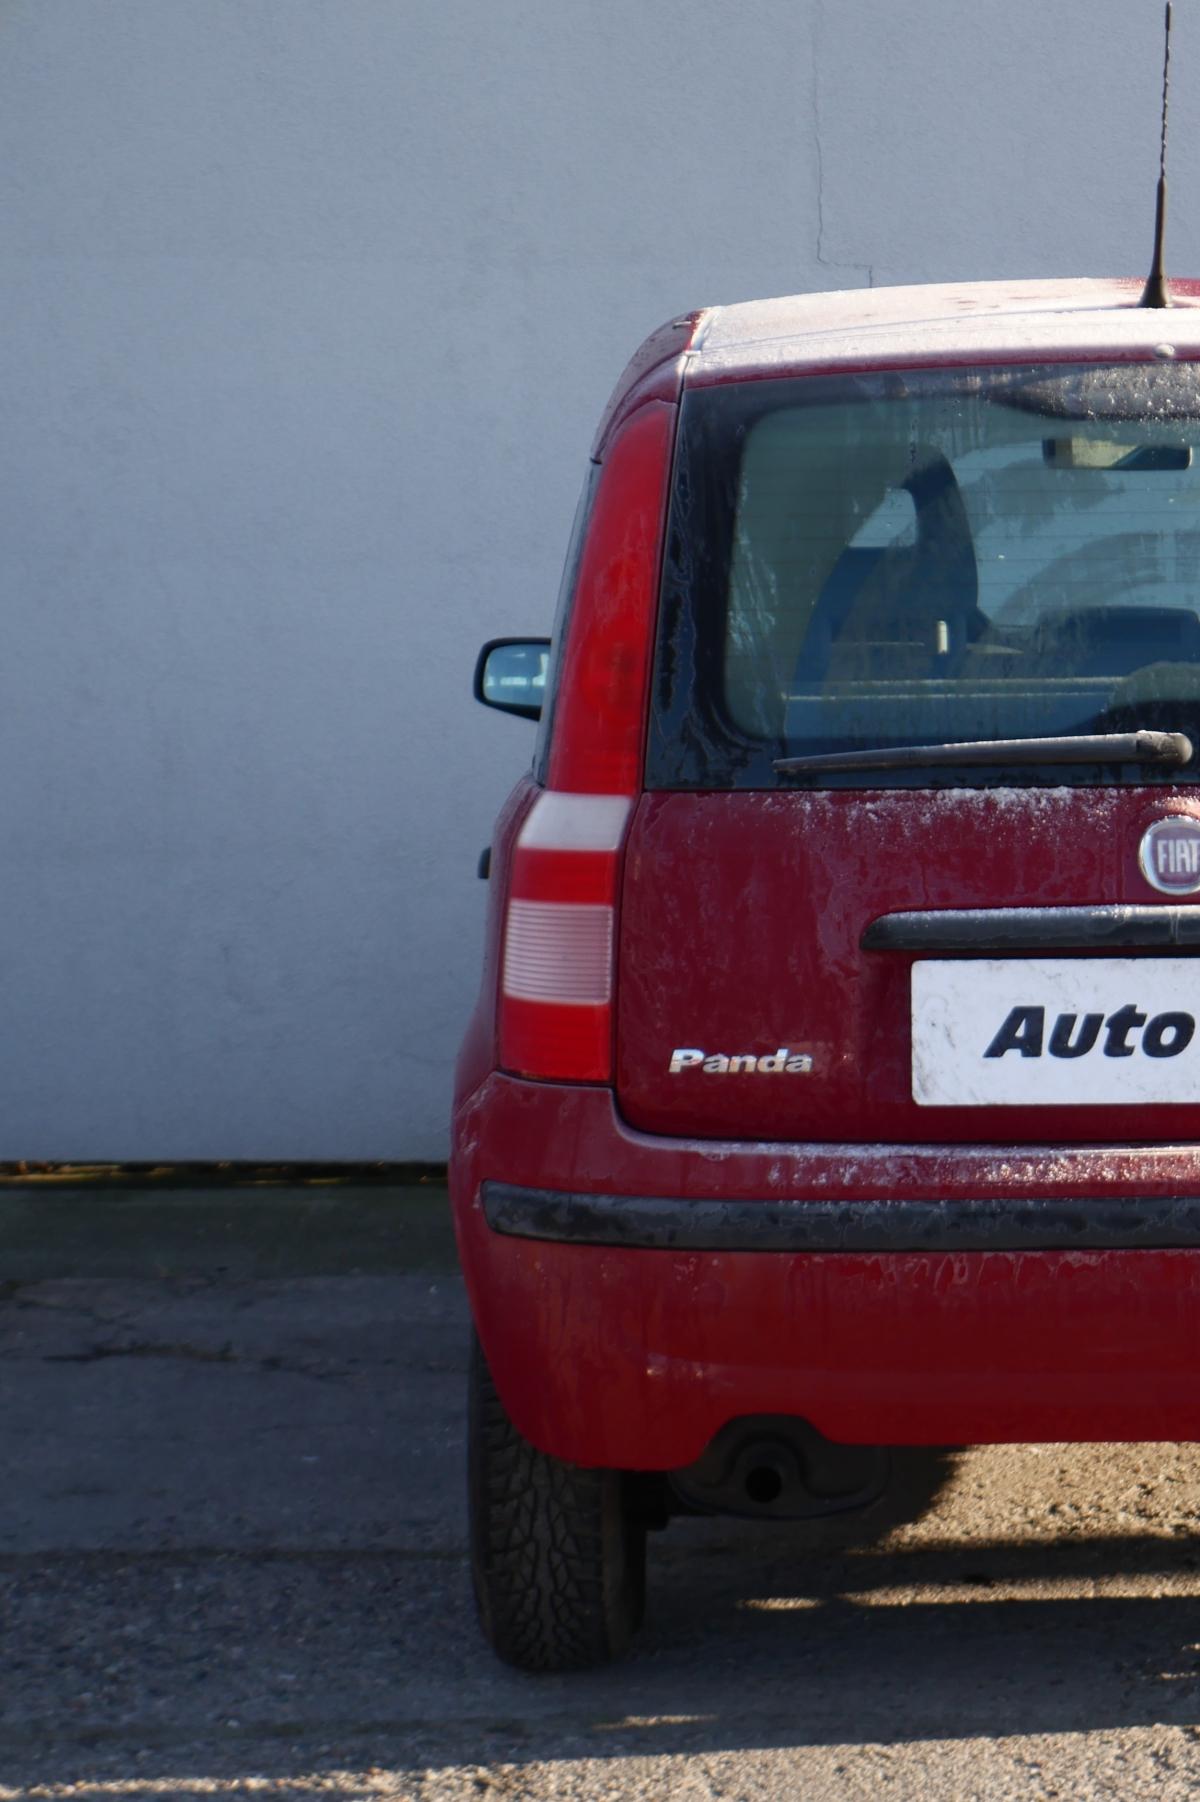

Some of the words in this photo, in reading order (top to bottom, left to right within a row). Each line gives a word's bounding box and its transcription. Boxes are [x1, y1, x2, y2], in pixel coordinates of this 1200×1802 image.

[1157, 839, 1200, 873] FIAT
[983, 1004, 1195, 1058] Auto
[668, 1048, 813, 1073] Panda
